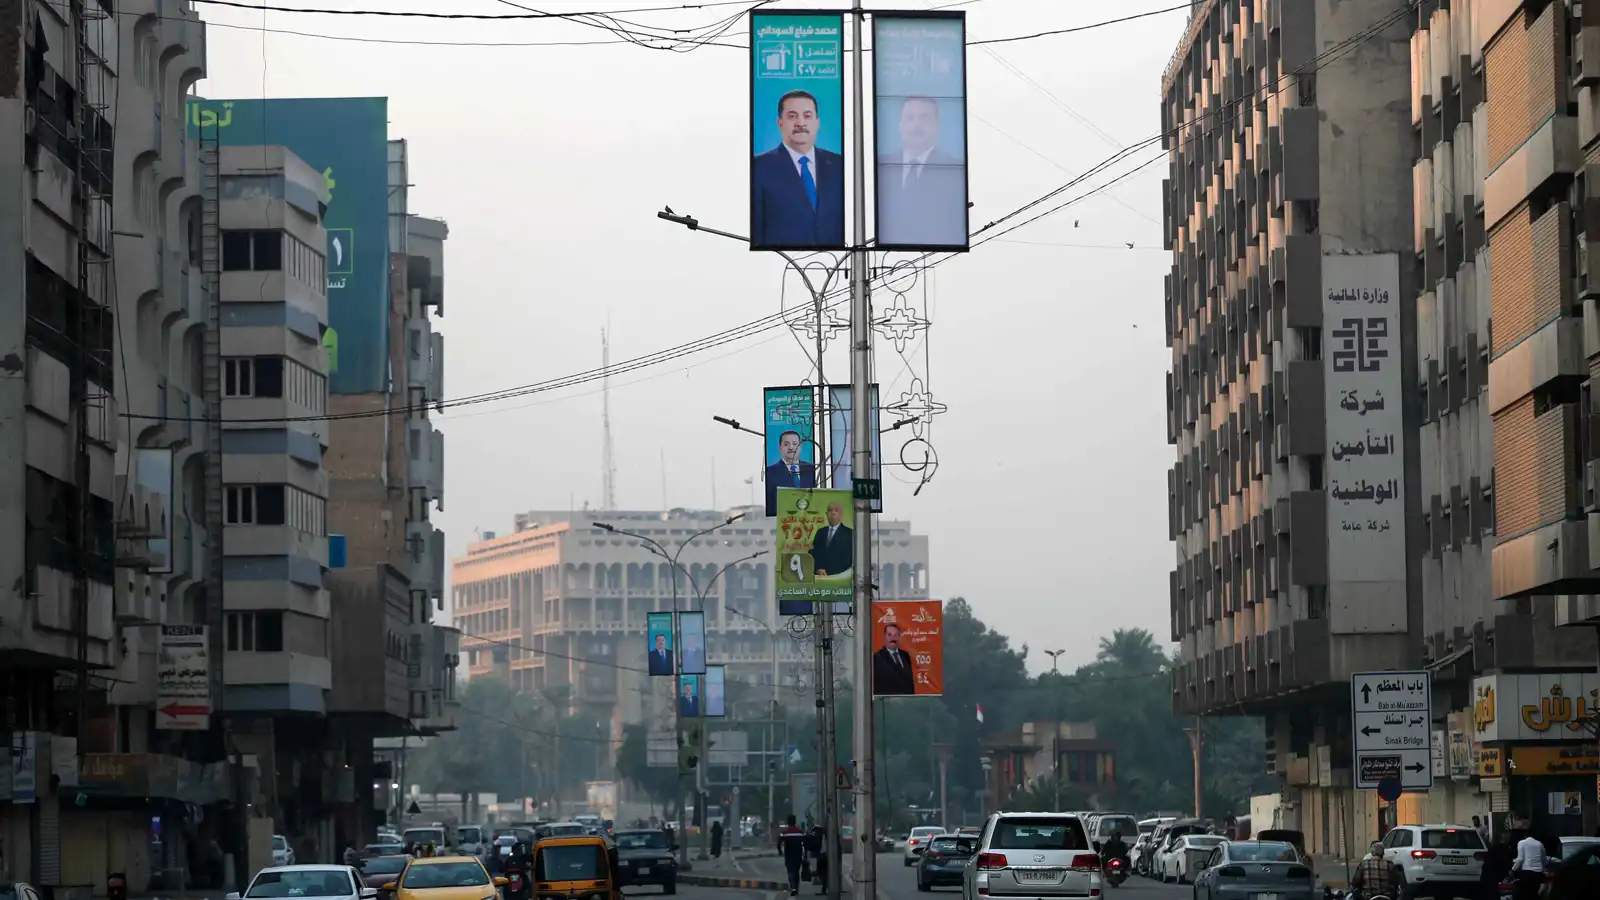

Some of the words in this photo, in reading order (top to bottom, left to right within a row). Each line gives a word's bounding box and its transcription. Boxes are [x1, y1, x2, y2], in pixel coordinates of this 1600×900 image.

[757, 25, 794, 38] السوداني
[332, 236, 343, 266] ١
[1328, 287, 1360, 304] المالية
[1363, 288, 1389, 304] وزارة
[1340, 389, 1385, 416] شركة
[1332, 428, 1395, 462] التأمين
[1331, 479, 1398, 506] الوطنية
[1342, 520, 1362, 531] عامة
[1367, 519, 1390, 532] شركة
[790, 555, 804, 581] ٩
[777, 587, 807, 598] الساعدي
[916, 654, 931, 665] ٢٥٥
[1407, 679, 1424, 695] باب
[1408, 716, 1424, 728] جسر
[1385, 737, 1402, 745] Sinak
[1403, 736, 1424, 746] Bridge
